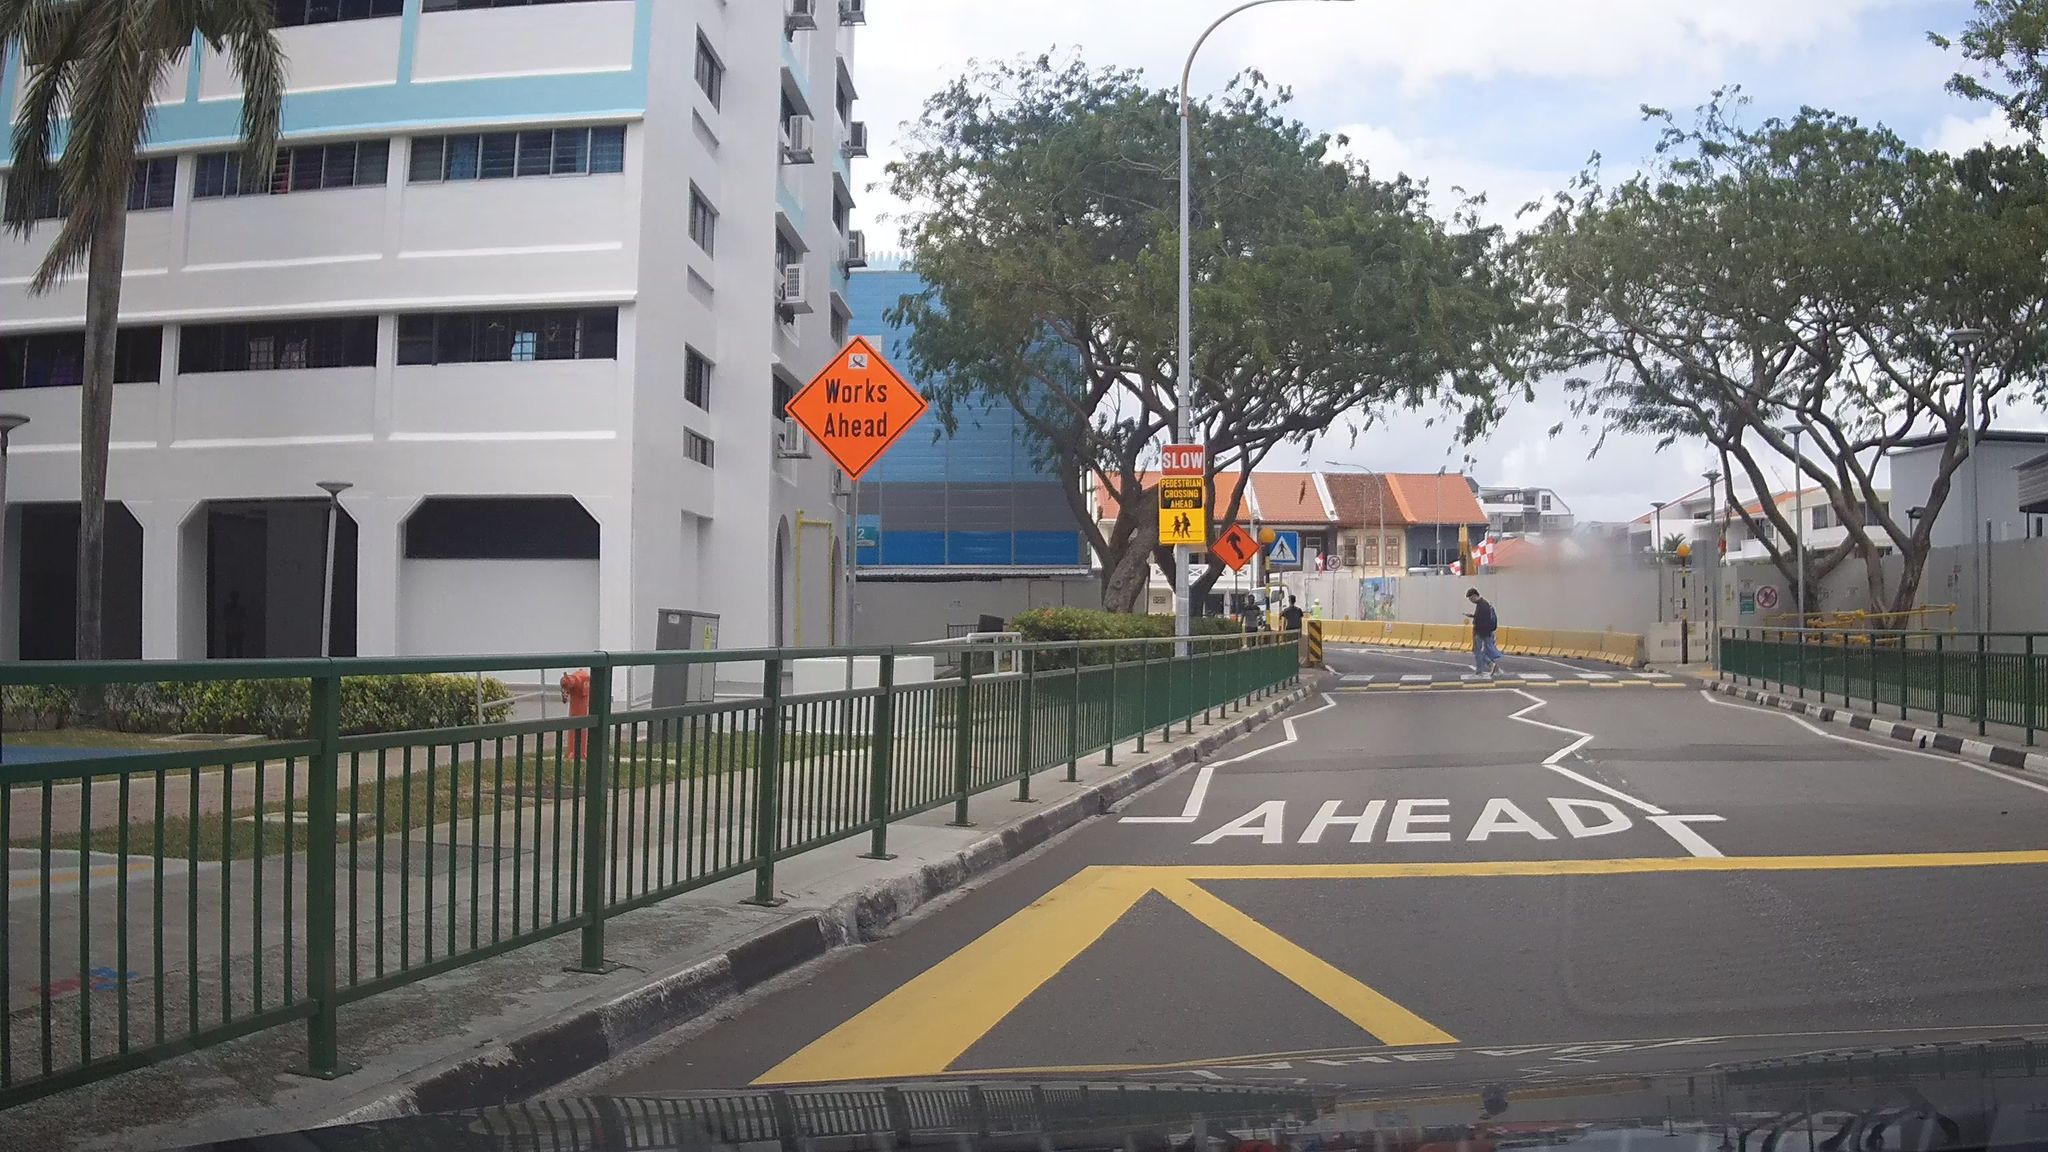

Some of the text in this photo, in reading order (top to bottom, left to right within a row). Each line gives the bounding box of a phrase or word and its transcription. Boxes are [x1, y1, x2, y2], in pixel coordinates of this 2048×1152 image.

[825, 378, 888, 403] Works
[823, 411, 887, 438] Ahead
[1162, 452, 1203, 469] SLOW
[1161, 479, 1202, 488] PEDESTRIAN
[1164, 489, 1199, 498] CROSSING
[1170, 499, 1194, 508] AHEAD
[1192, 798, 1634, 845] AHEAD
